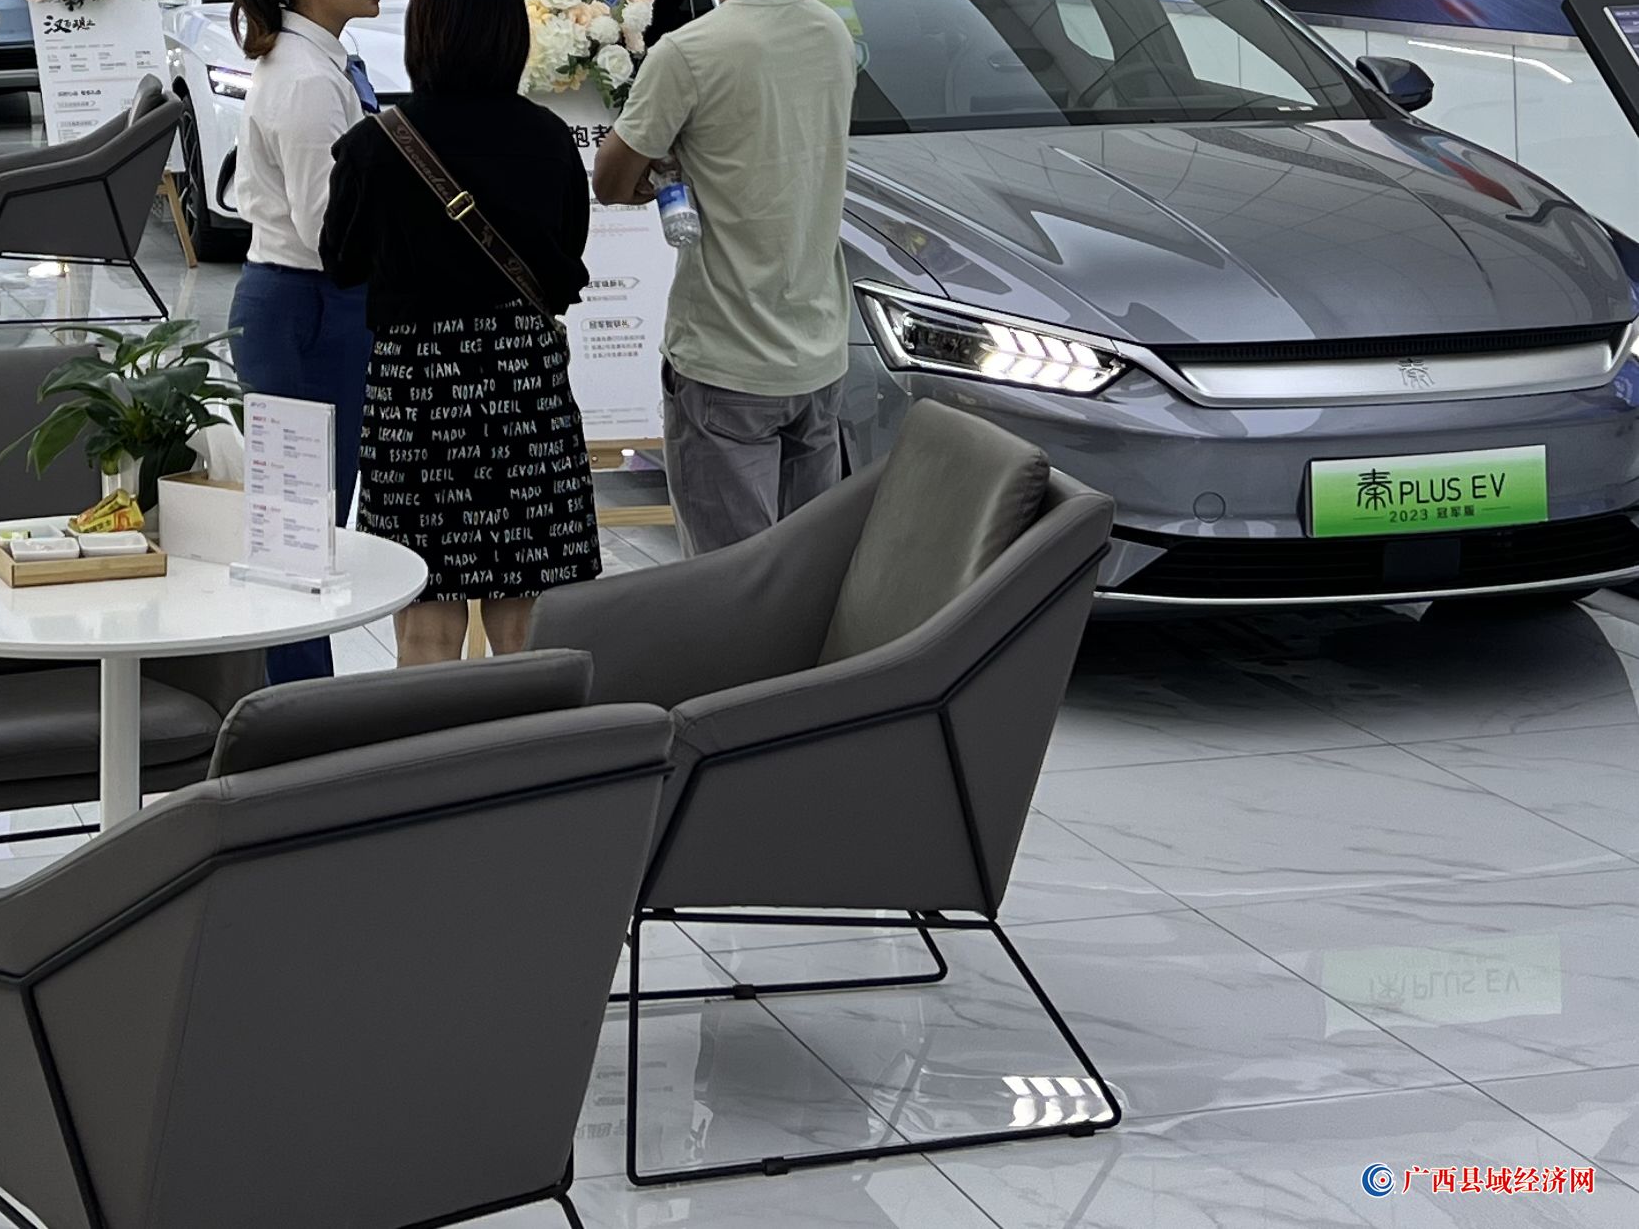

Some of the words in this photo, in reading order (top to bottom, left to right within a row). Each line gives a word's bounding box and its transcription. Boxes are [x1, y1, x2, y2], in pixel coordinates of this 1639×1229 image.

[1471, 472, 1506, 499] EV
[1389, 508, 1429, 523] 2023
[1436, 505, 1476, 519] 冠军版
